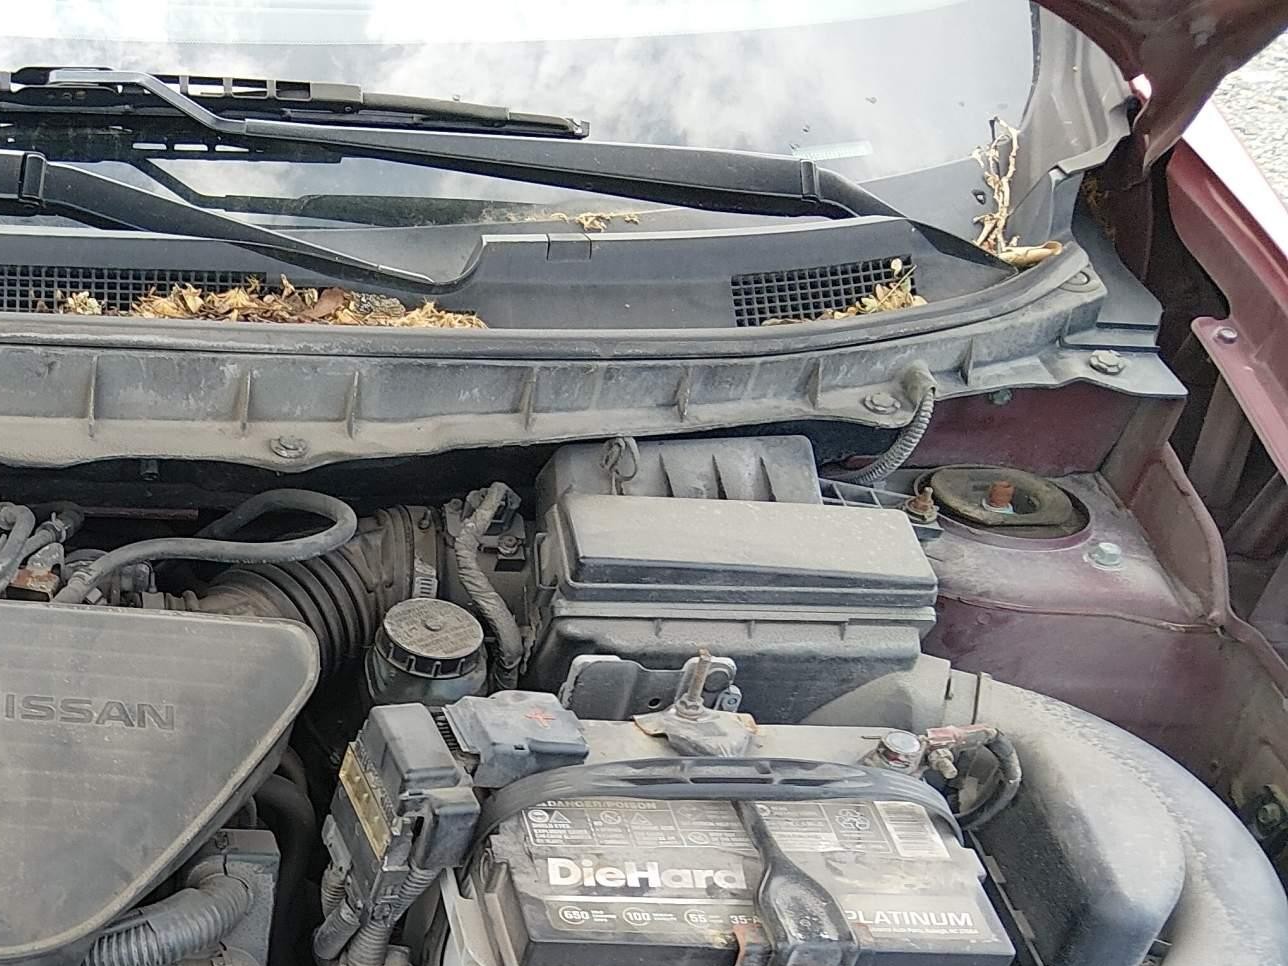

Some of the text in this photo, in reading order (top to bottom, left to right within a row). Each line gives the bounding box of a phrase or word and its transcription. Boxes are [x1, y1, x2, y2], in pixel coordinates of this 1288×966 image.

[548, 800, 657, 810] DANGER/POISON
[547, 857, 748, 890] DieHard
[626, 911, 652, 921] 100
